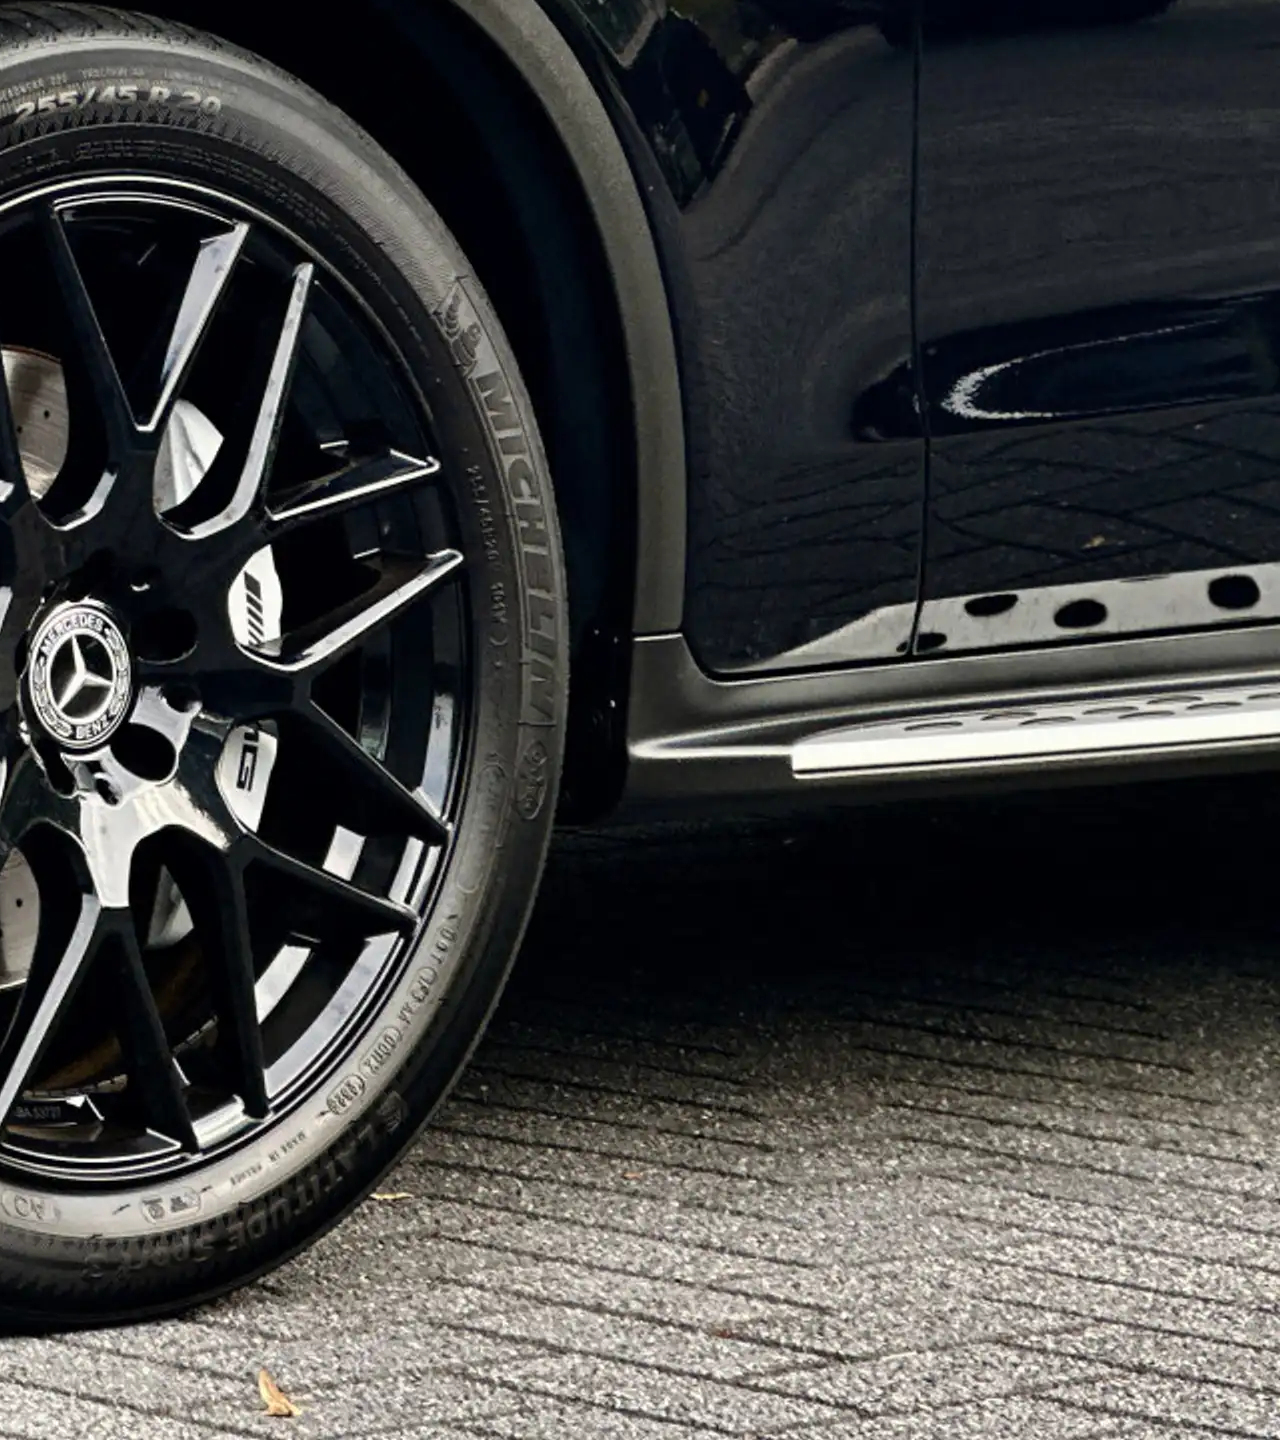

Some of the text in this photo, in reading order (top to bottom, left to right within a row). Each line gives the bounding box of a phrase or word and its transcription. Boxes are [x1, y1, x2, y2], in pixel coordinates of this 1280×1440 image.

[15, 85, 223, 124] 255/45 R 20
[475, 371, 557, 721] MICHELIN
[40, 613, 104, 656] MERCEDES
[75, 714, 110, 739] BENZ
[223, 1128, 383, 1252] LATITUDE
